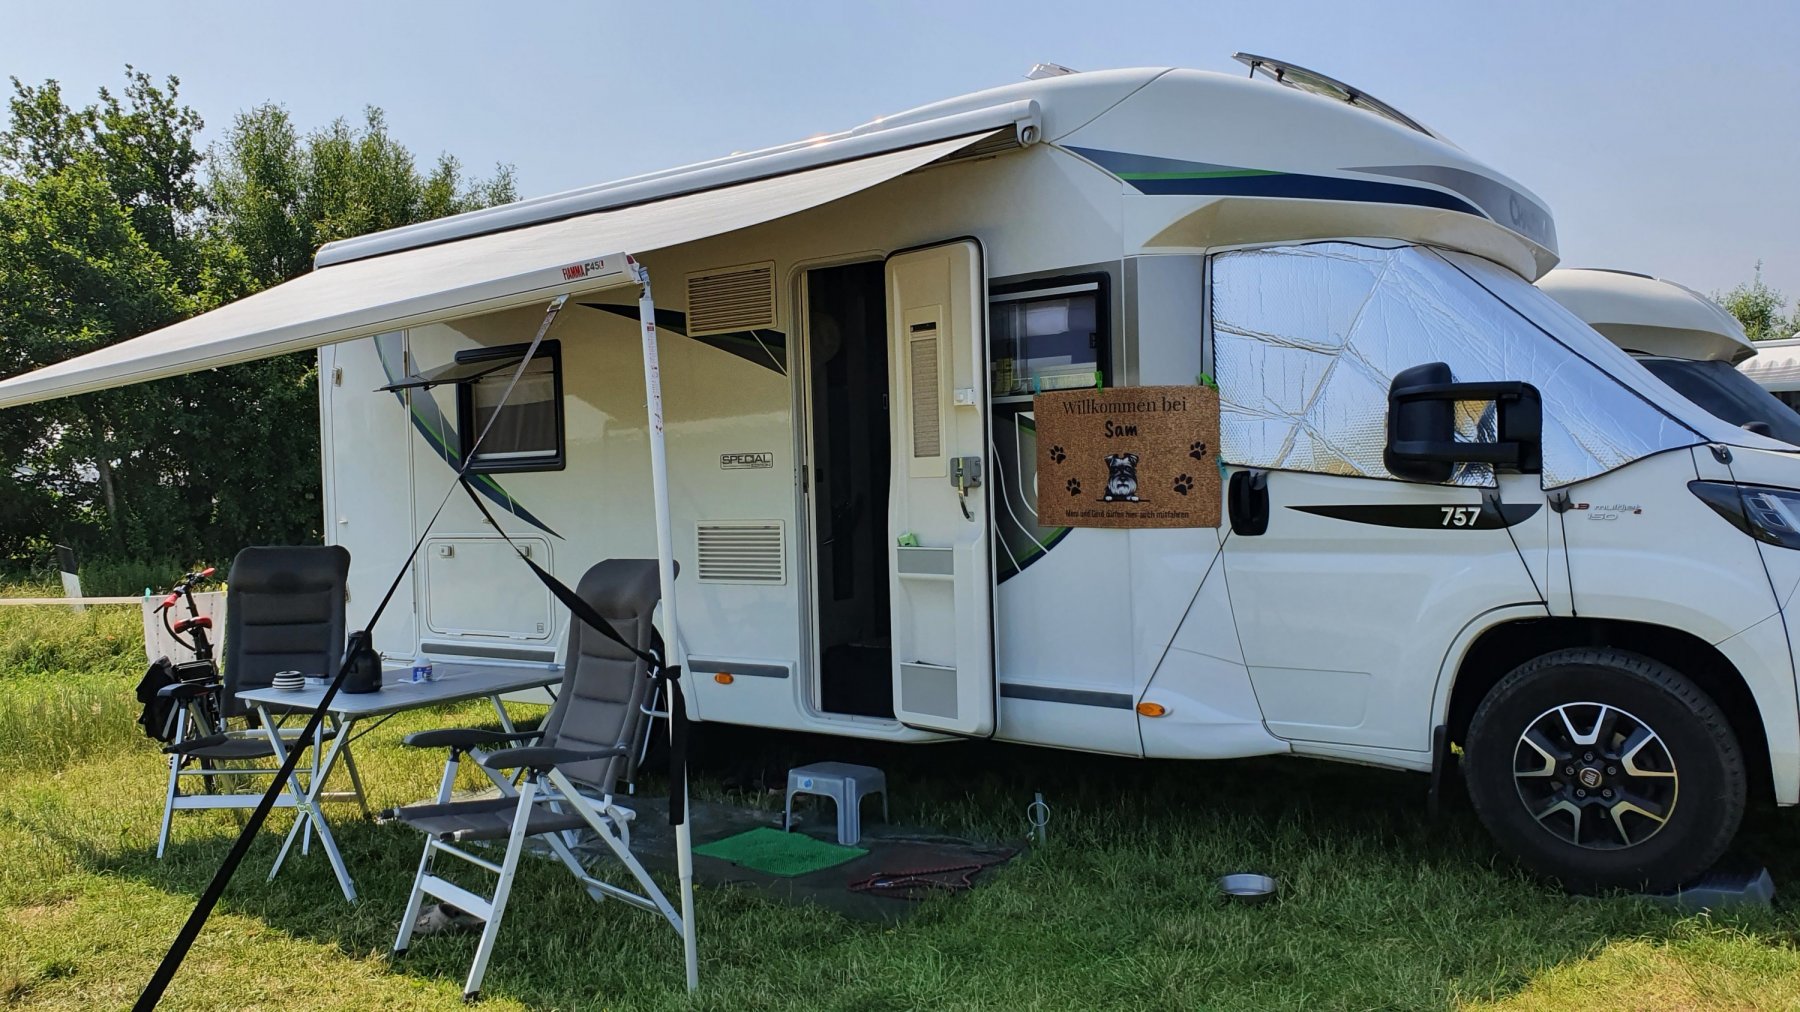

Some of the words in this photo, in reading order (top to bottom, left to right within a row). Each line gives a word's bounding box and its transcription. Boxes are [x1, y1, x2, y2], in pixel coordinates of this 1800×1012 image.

[562, 264, 585, 280] FIAMMA
[1063, 398, 1156, 415] Willkommen
[1161, 396, 1187, 412] bei
[1104, 420, 1138, 439] Sam
[722, 454, 771, 464] SPECIAL
[1156, 509, 1190, 519] mitfahren
[1441, 506, 1481, 526] 757
[1587, 513, 1619, 521] 150
